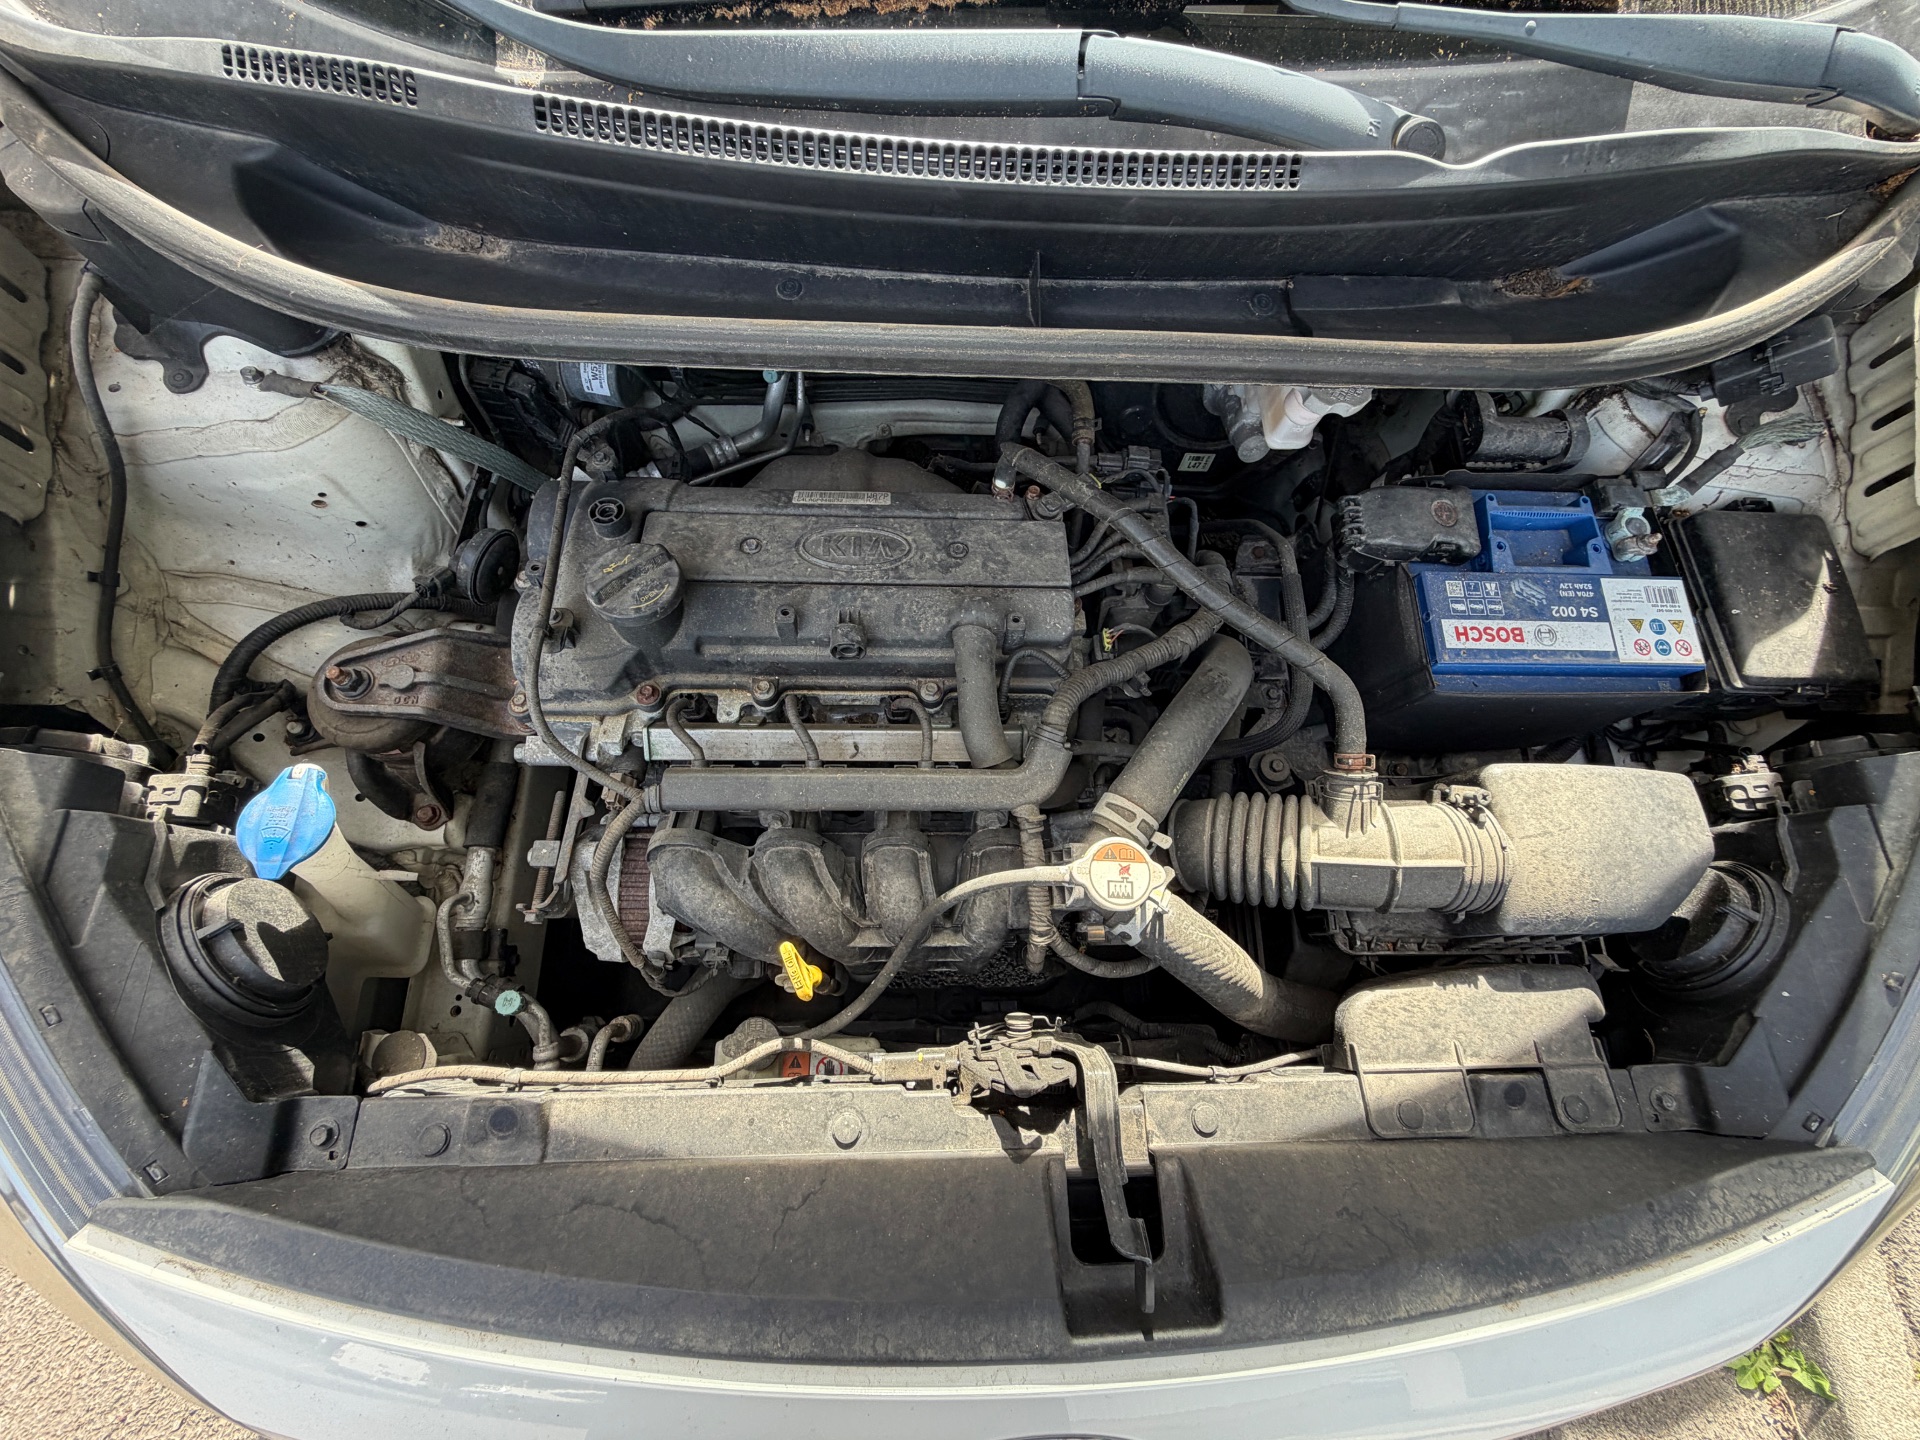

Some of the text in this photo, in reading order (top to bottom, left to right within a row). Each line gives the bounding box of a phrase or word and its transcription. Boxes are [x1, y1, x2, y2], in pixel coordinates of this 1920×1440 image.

[820, 535, 894, 559] KIA
[1559, 582, 1593, 590] 52Ah 12V
[640, 589, 659, 602] OPEN
[1551, 605, 1576, 618] 002
[1580, 605, 1599, 618] S4
[1454, 625, 1525, 643] BOSCH
